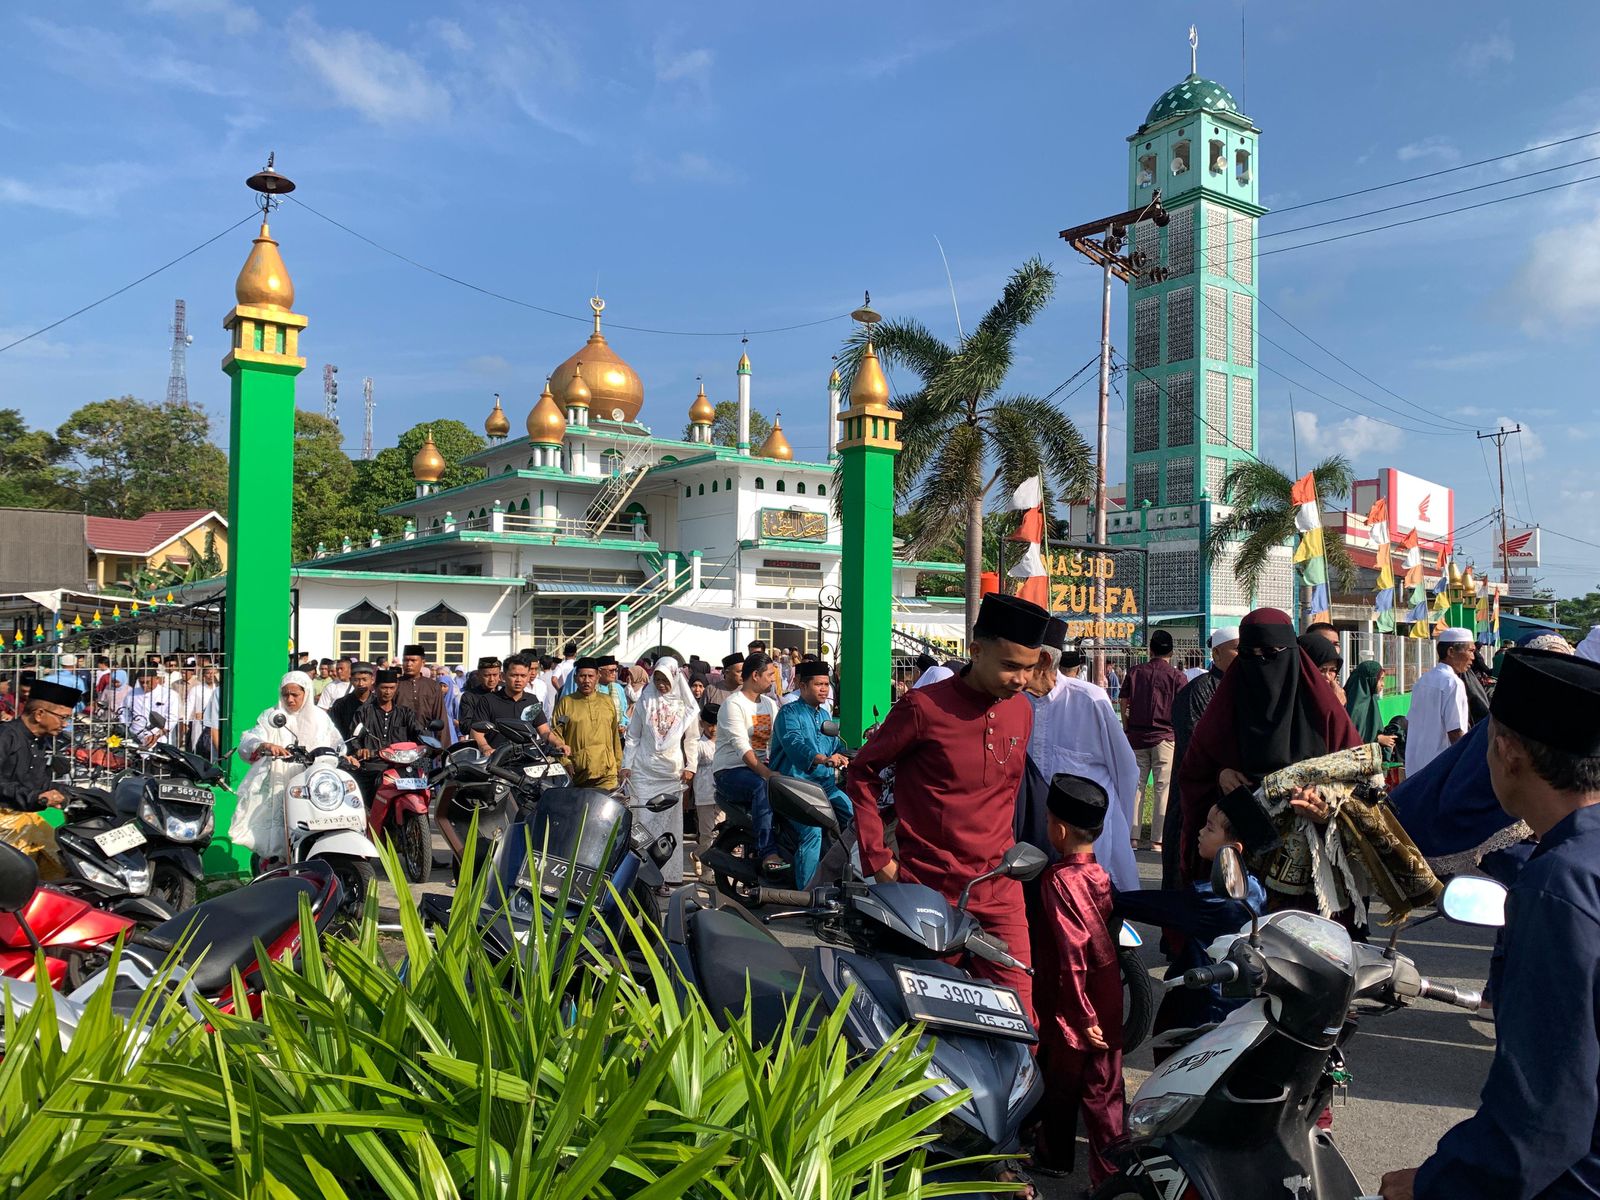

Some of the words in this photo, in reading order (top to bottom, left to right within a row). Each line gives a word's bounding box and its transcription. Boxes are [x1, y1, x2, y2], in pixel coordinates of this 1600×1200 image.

[1040, 554, 1115, 579] MASJID
[161, 785, 173, 793] BP
[916, 908, 944, 918] HONDA
[905, 976, 929, 997] BP
[940, 984, 987, 1008] 3902
[996, 991, 1018, 1012] LJ
